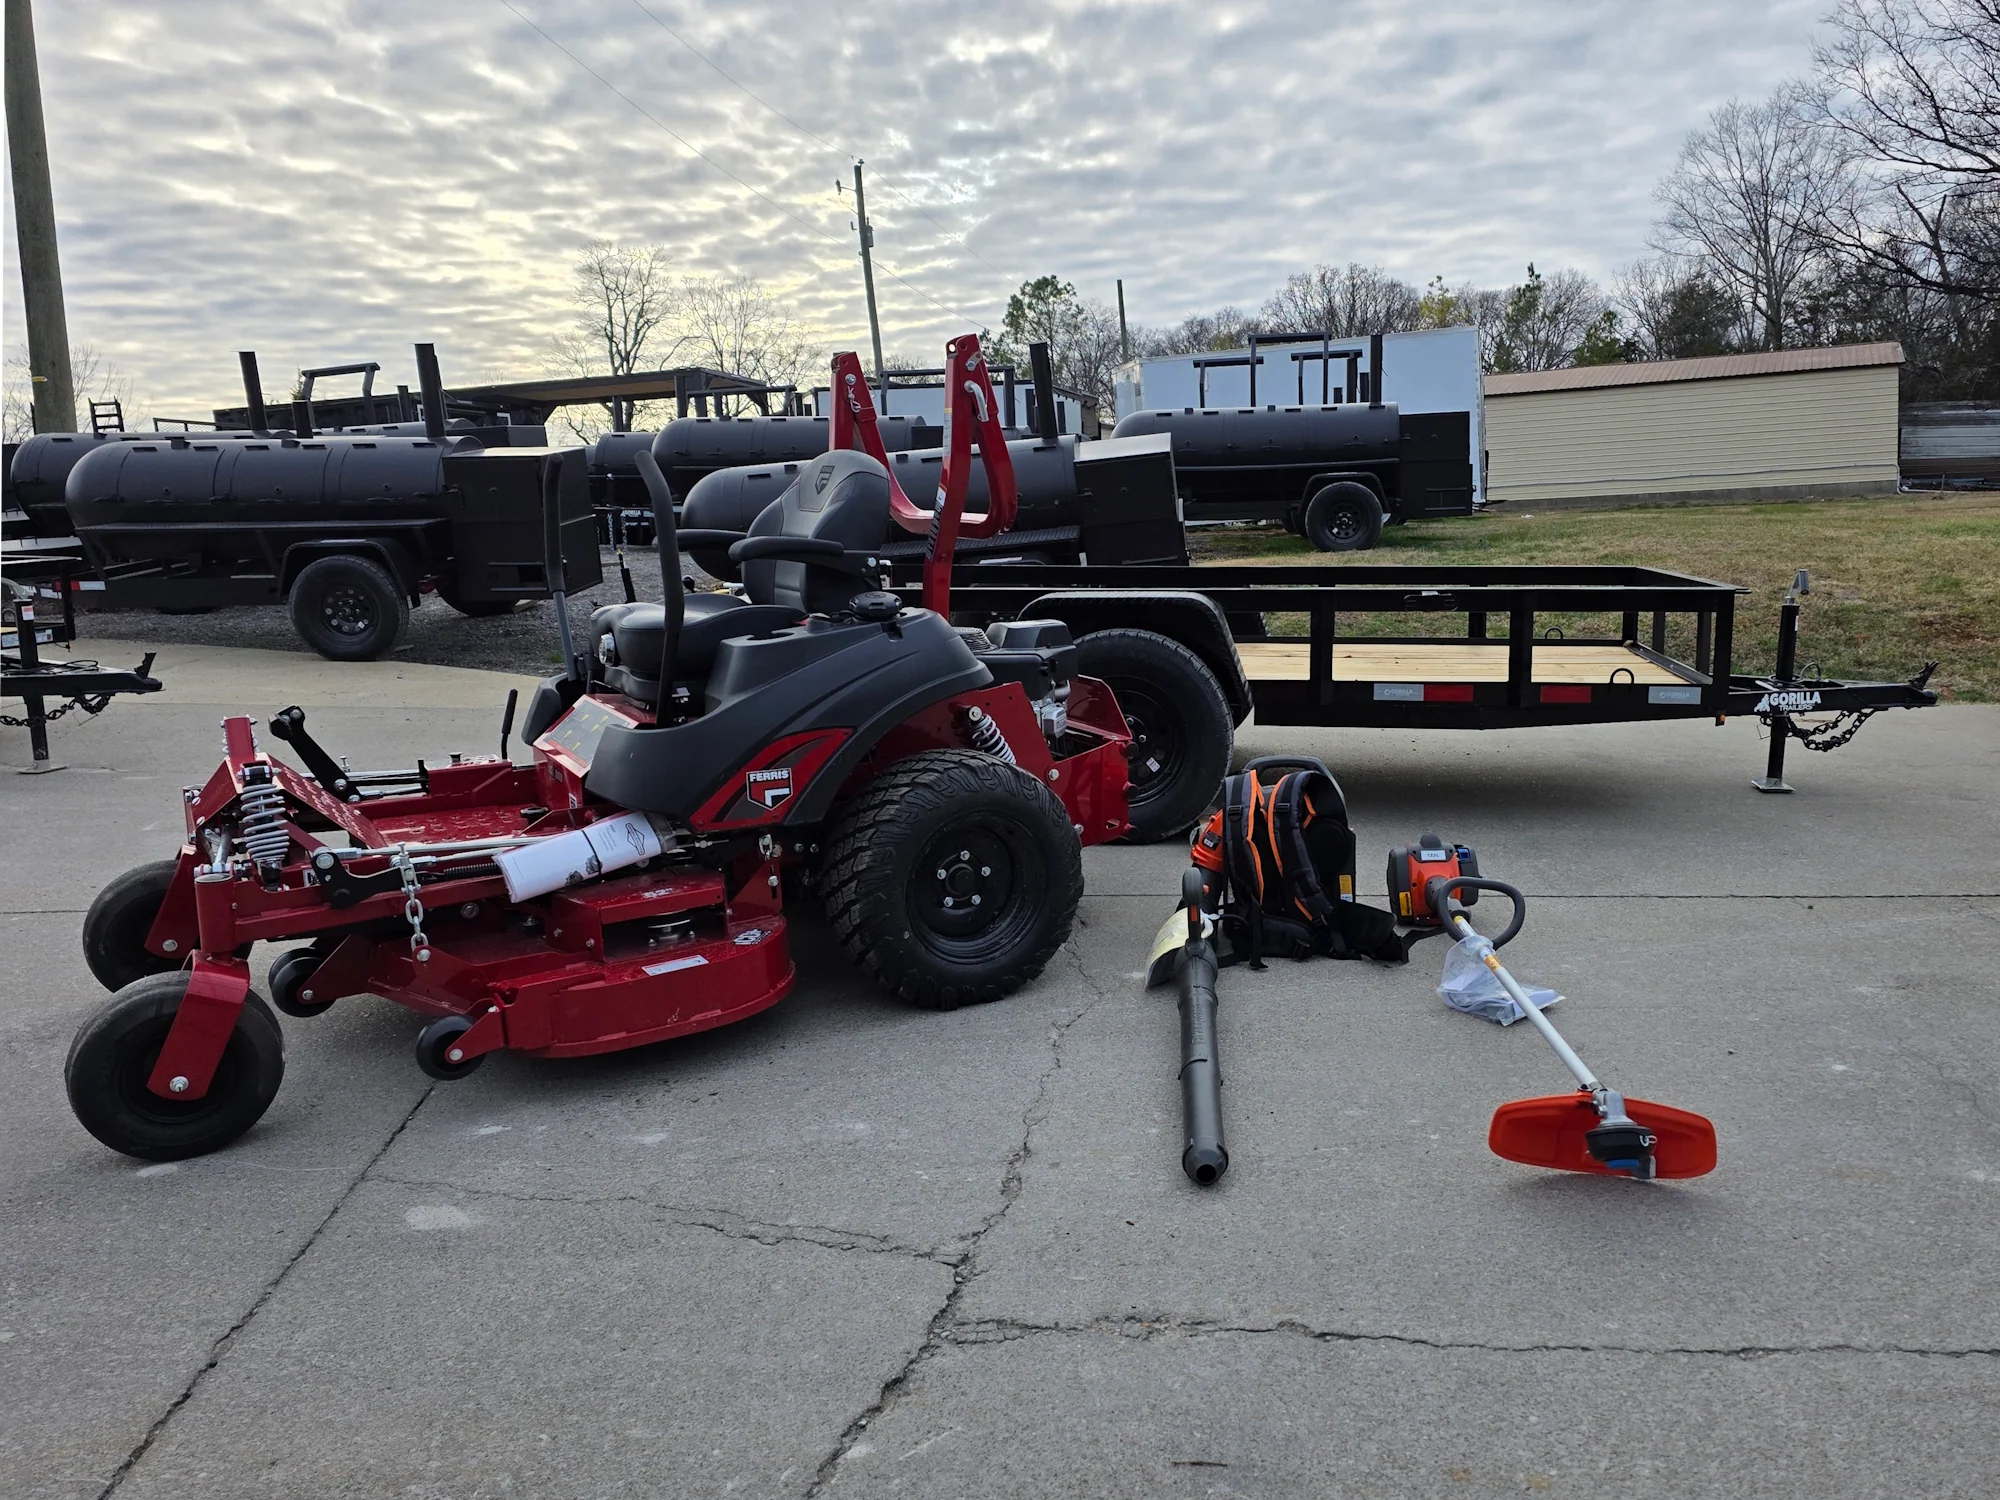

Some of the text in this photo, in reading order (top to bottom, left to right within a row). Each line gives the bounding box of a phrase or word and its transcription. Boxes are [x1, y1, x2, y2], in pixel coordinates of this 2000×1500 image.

[1769, 691, 1821, 706] GORILLA
[1778, 703, 1813, 711] TRAILERS
[749, 770, 789, 782] FERRIS
